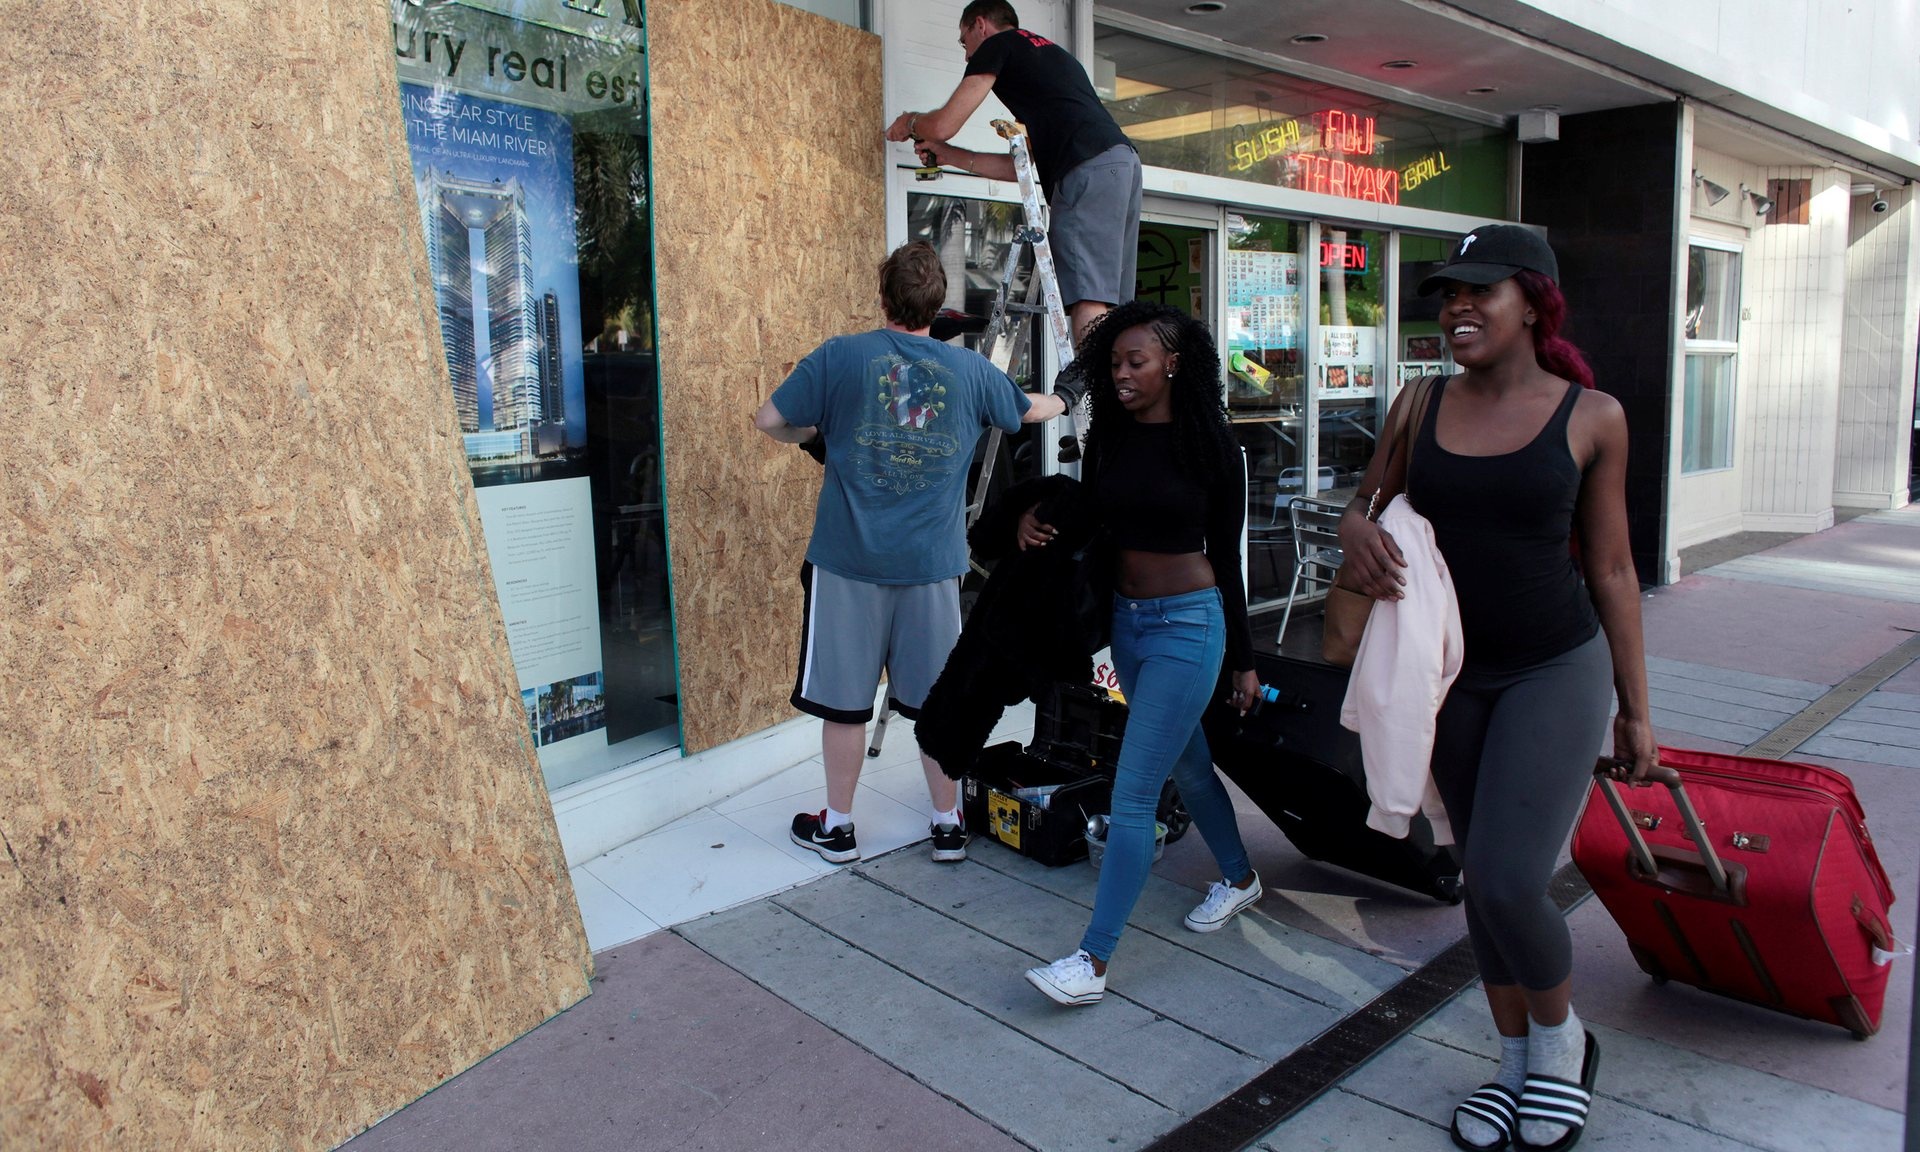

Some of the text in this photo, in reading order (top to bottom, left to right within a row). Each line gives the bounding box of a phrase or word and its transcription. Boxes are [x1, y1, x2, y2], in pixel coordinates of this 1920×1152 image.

[488, 46, 567, 92] real
[586, 70, 647, 109] est
[413, 119, 448, 141] THE
[452, 126, 500, 149] MIAMI
[504, 135, 547, 157] RIVER
[486, 108, 534, 132] STYLE
[1326, 110, 1374, 155] FUJI
[1234, 119, 1300, 171] SUSHI
[1298, 154, 1398, 206] TERIYAKI
[1404, 151, 1451, 191] GRILL
[1320, 242, 1366, 269] OPEN
